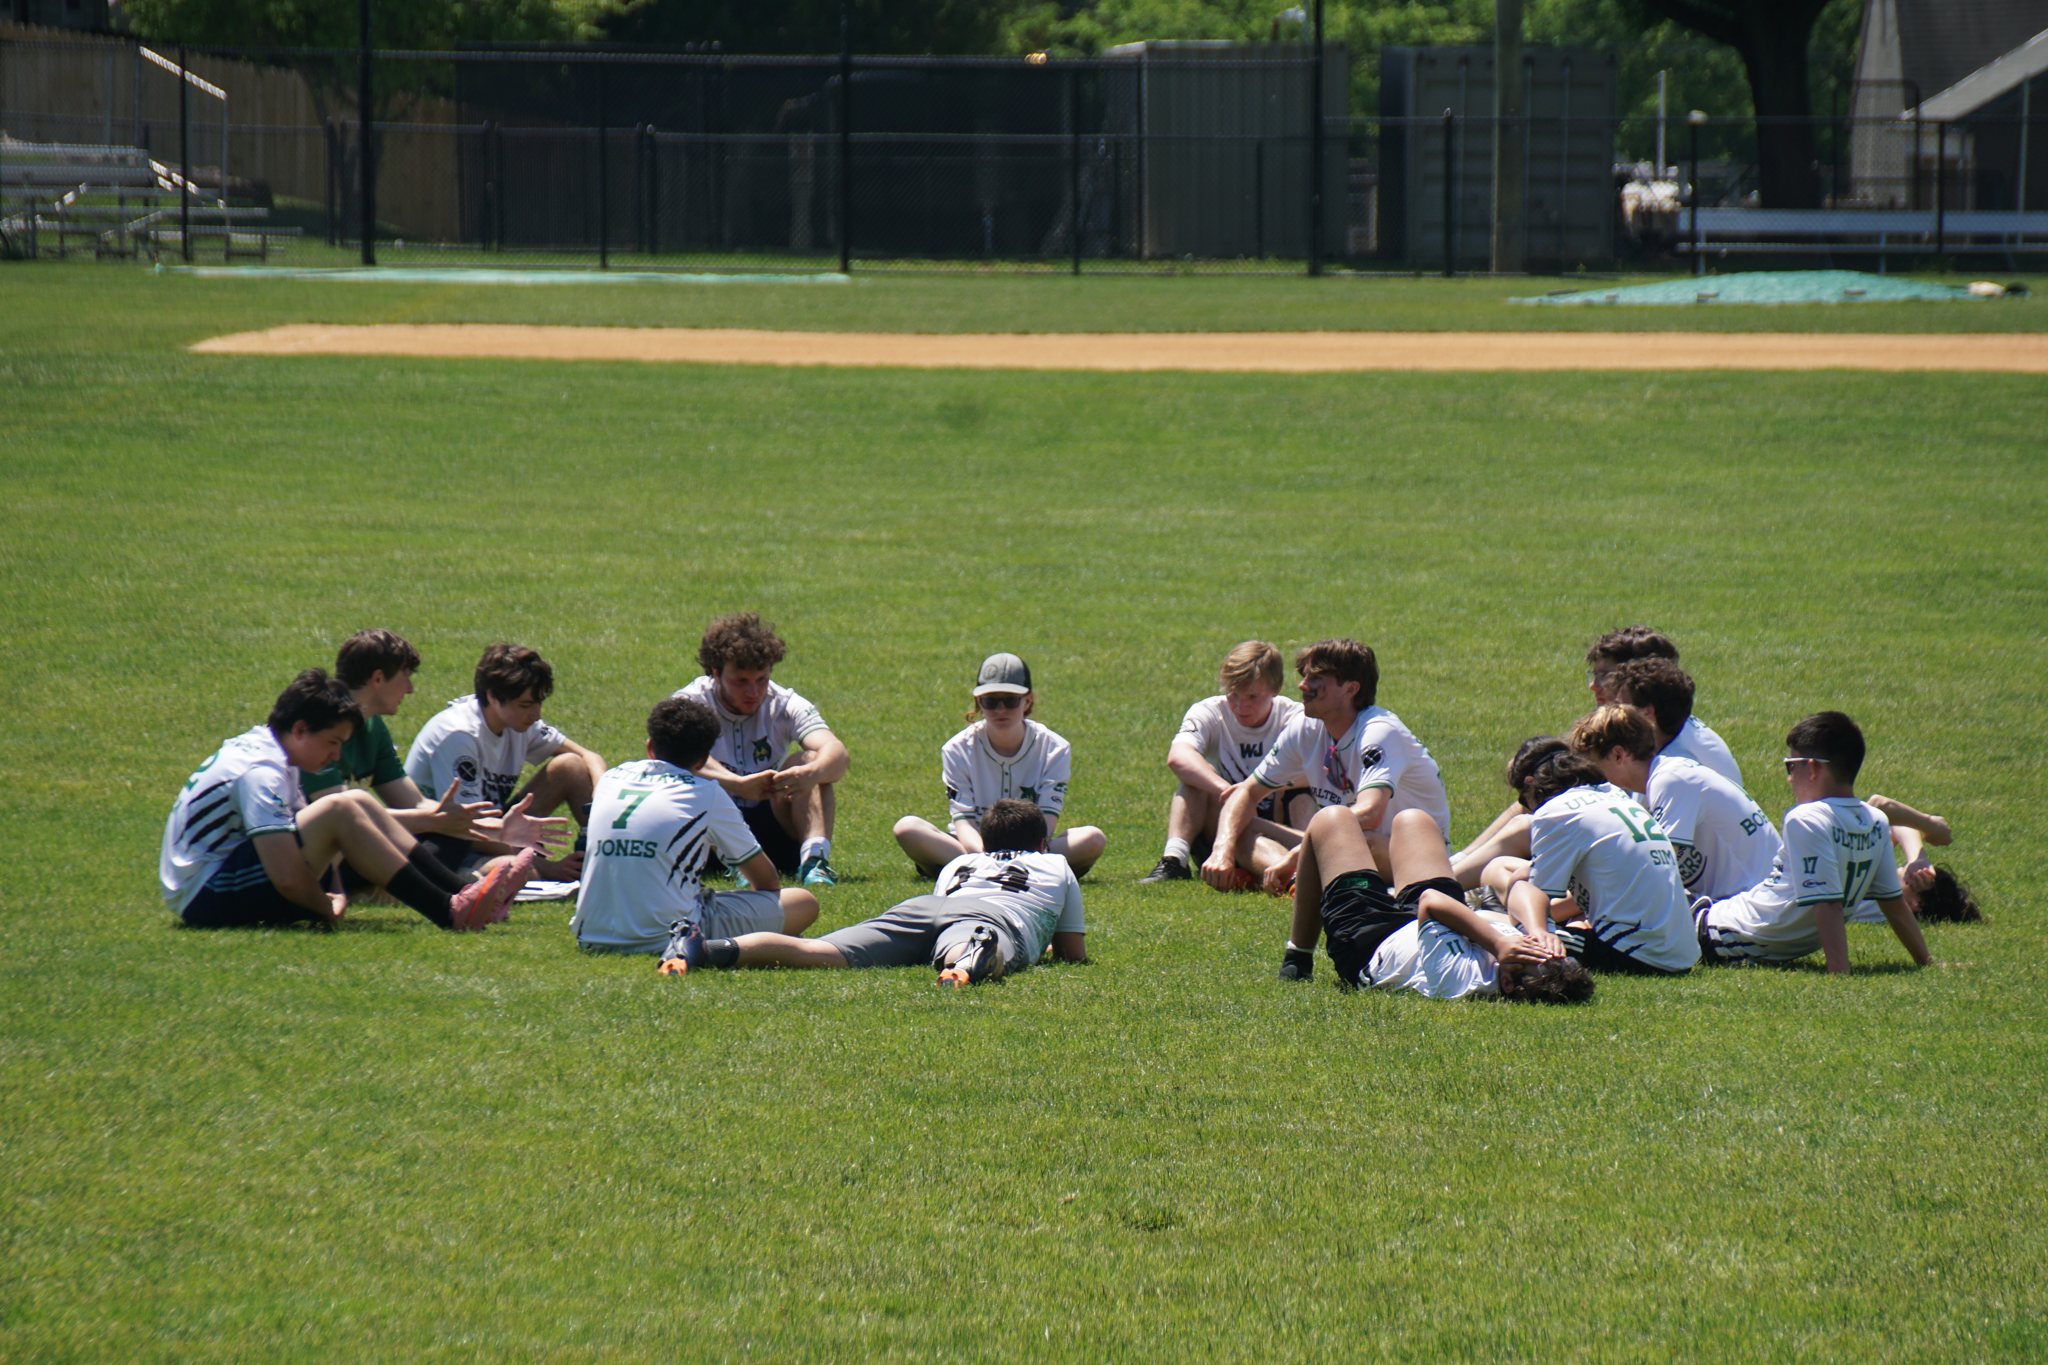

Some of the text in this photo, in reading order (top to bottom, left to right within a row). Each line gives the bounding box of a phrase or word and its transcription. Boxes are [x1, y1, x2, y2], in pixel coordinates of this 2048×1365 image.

[1240, 741, 1264, 759] WJ
[611, 789, 654, 829] 7
[1608, 806, 1668, 843] 12
[595, 839, 658, 859] JONES
[1679, 847, 1703, 882] ERS
[1803, 856, 1819, 874] 17
[1843, 860, 1873, 908] 17
[1446, 939, 1465, 957] 11
